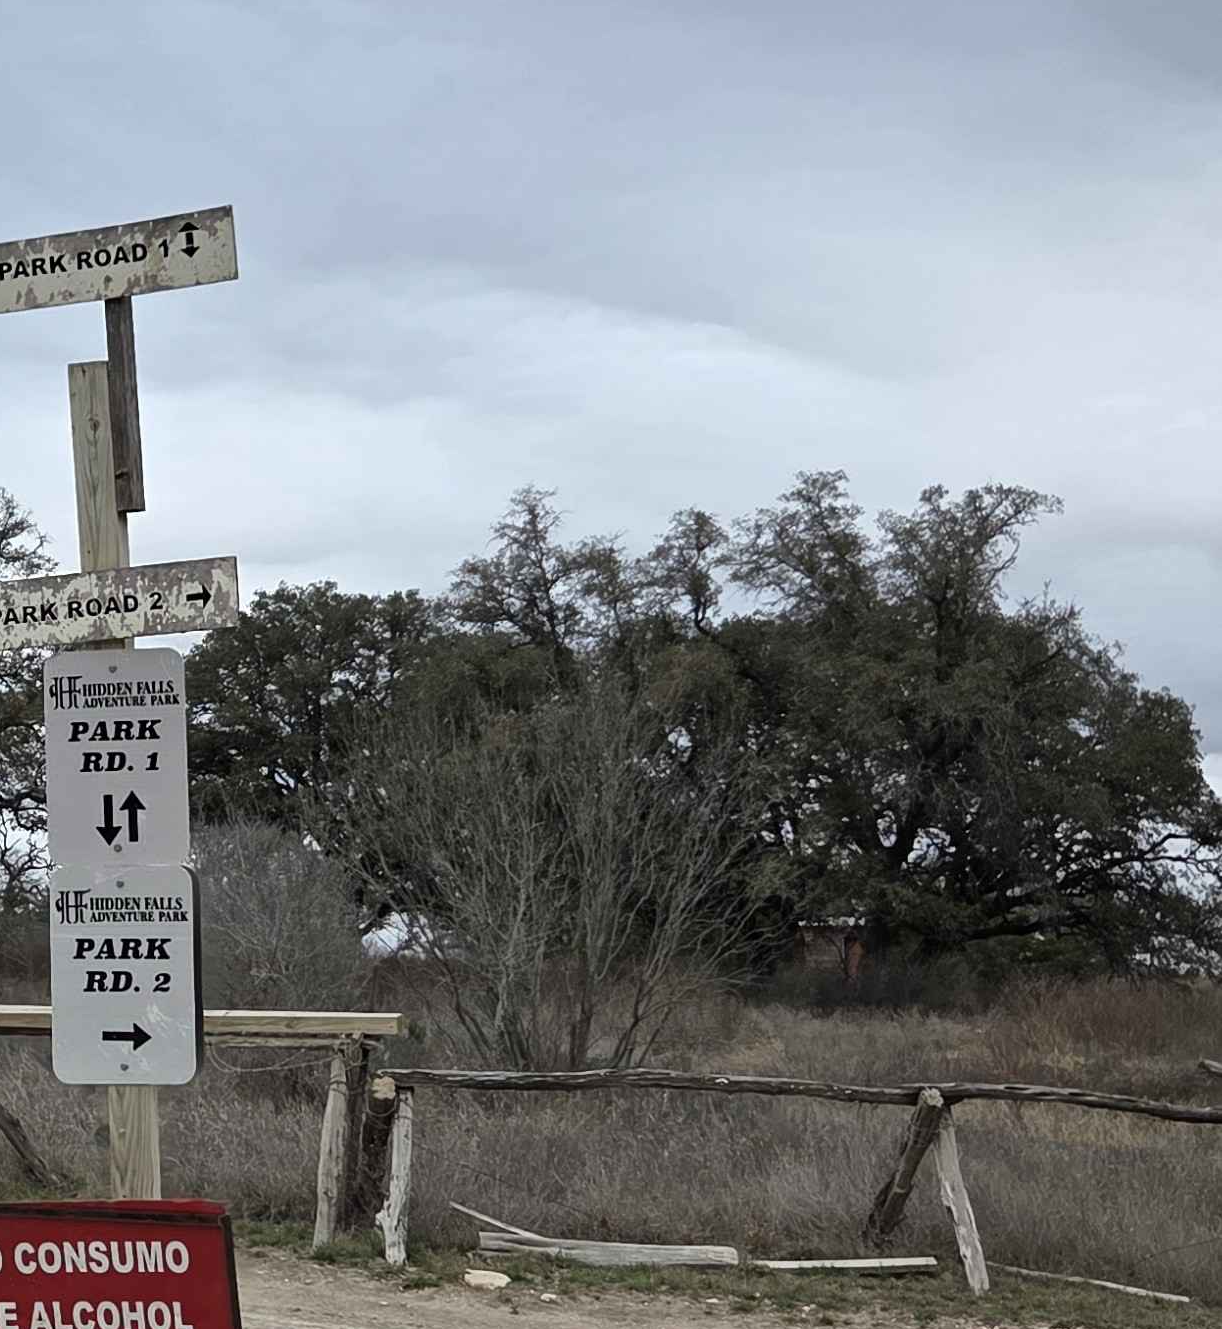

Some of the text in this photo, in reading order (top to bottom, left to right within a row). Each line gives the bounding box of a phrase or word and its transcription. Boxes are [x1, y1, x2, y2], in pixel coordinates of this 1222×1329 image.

[76, 243, 148, 269] ROAD
[159, 239, 171, 258] 1
[67, 595, 139, 619] ROAD
[149, 592, 163, 610] 2
[82, 680, 174, 697] HIDDEN FALLS
[83, 694, 180, 709] ADVENTURE PARK
[68, 719, 162, 742] PARK
[80, 752, 160, 772] RD. 1
[90, 897, 183, 911] HIDDEN FALLS
[90, 911, 188, 922] ADVENTURE PARK
[73, 938, 171, 960] PARK
[83, 971, 171, 992] RD. 2
[14, 1241, 189, 1274] CONSUMO
